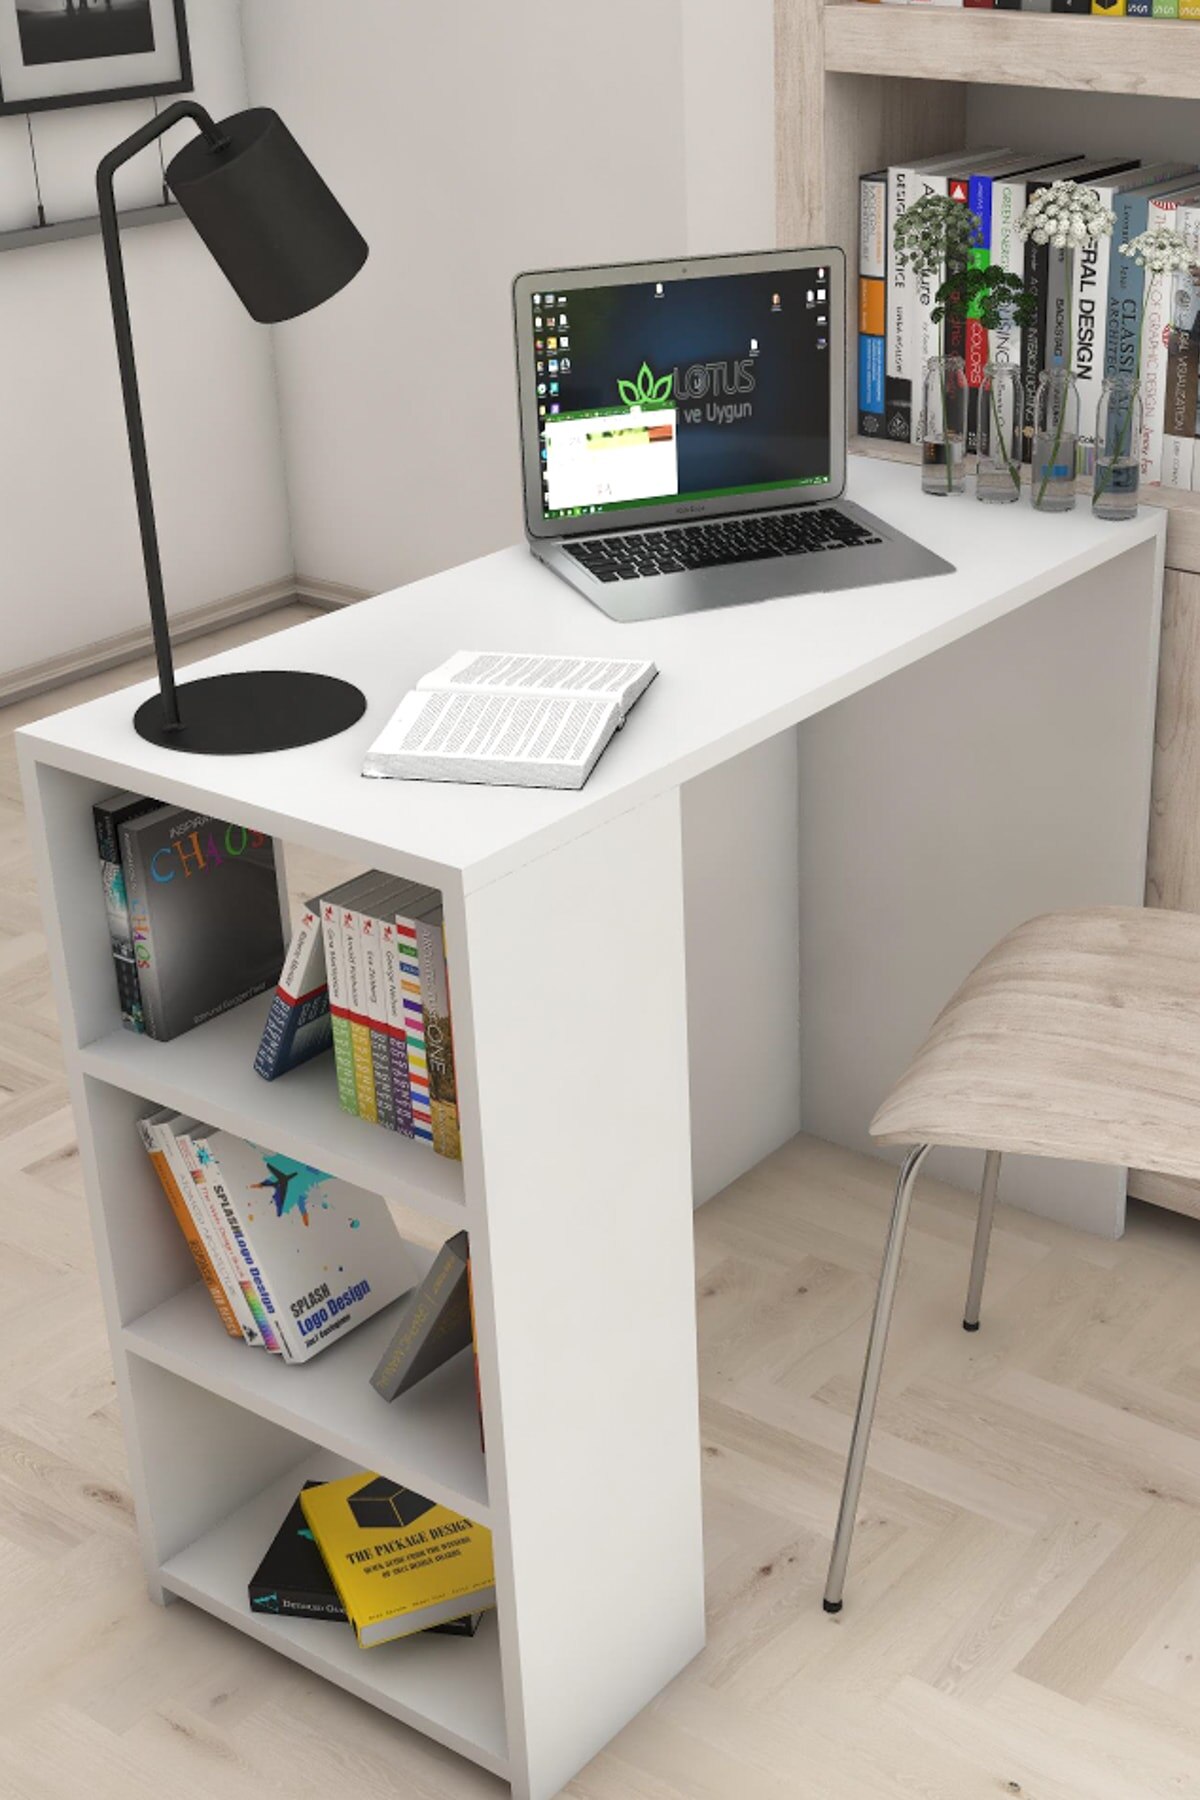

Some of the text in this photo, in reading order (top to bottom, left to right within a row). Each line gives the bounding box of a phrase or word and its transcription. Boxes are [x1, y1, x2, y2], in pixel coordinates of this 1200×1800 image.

[1001, 187, 1012, 224] GREEN
[970, 322, 984, 385] COLORS
[1076, 298, 1096, 380] DESIGN
[1118, 298, 1137, 416] CLASSIAL
[683, 408, 701, 423] ve
[706, 402, 753, 424] Uygun
[249, 1267, 275, 1314] Design
[290, 1282, 331, 1318] SPLASH
[296, 1307, 328, 1336] Logo
[326, 1279, 371, 1316] Design
[345, 1518, 473, 1565] THE PACKAGE DESIGN
